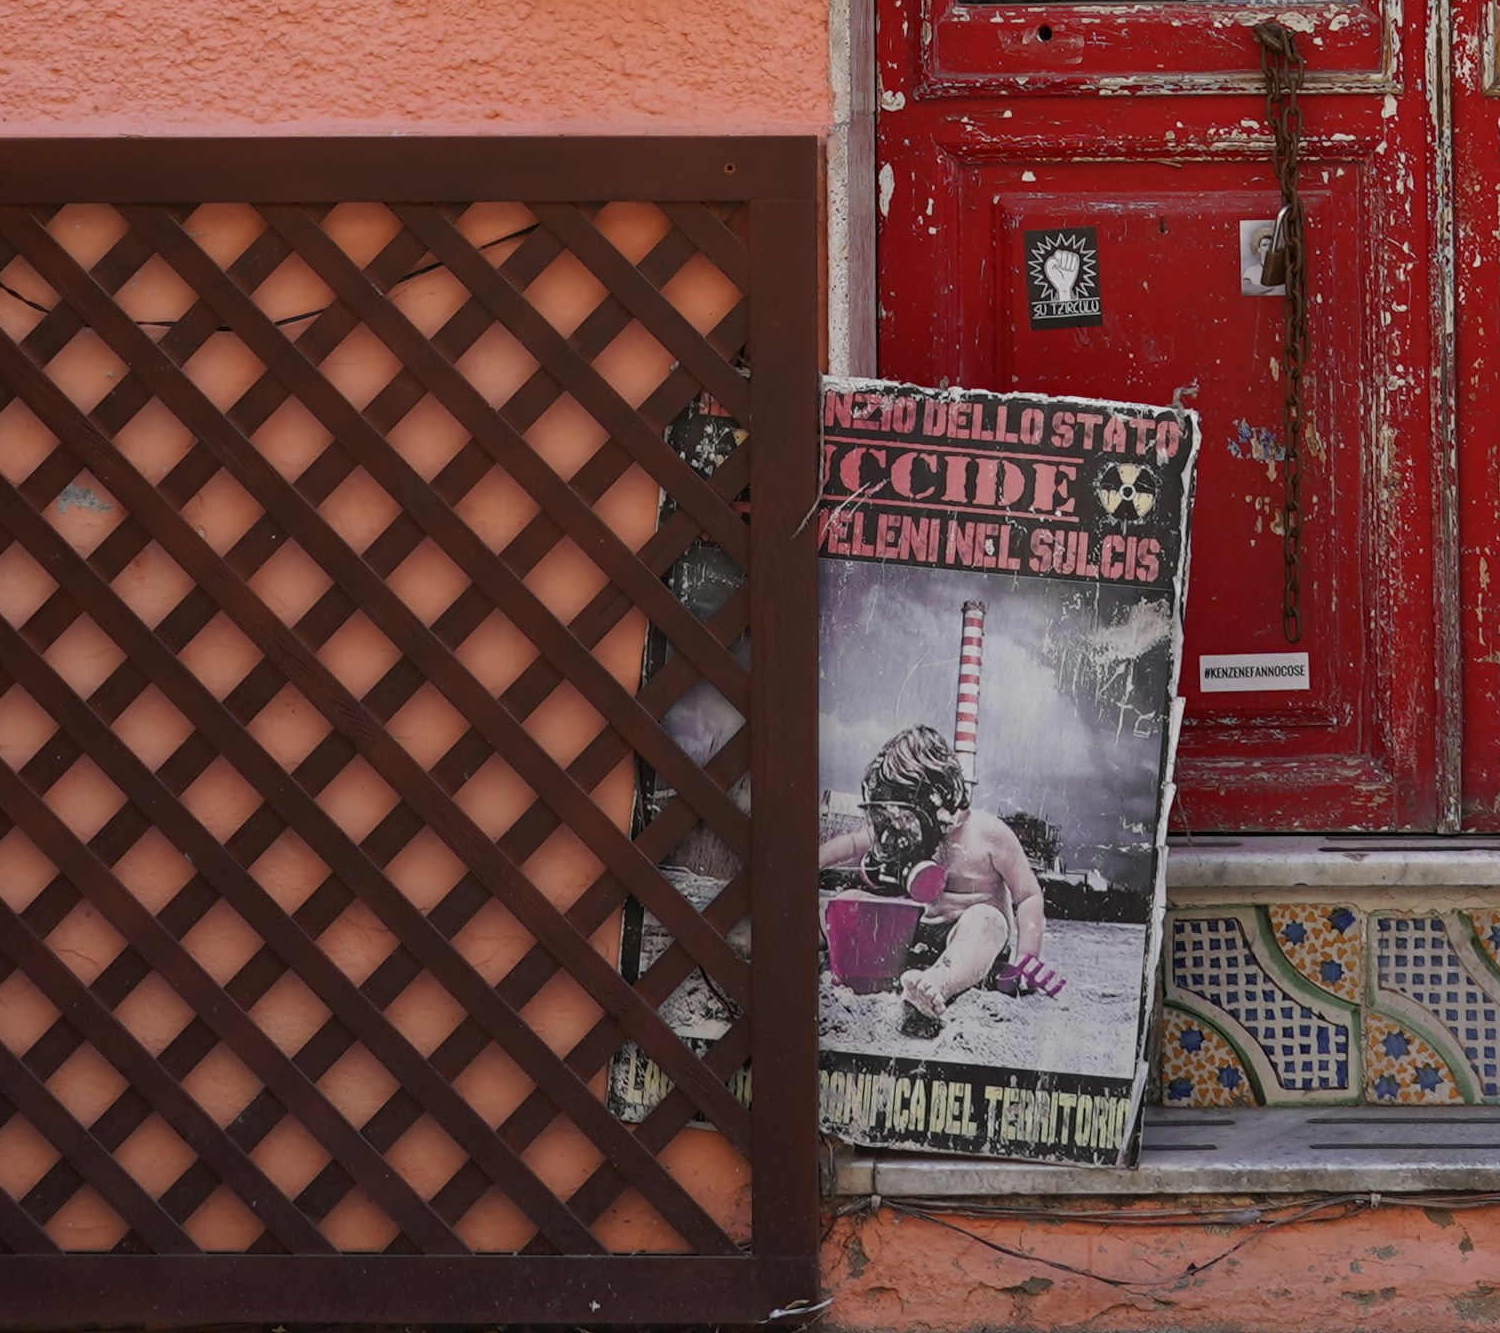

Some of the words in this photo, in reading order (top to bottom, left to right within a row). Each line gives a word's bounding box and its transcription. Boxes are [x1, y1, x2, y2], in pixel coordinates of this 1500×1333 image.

[1033, 304, 1047, 317] SU
[923, 400, 1045, 445] DELLO
[1051, 411, 1181, 458] STATO
[945, 520, 1021, 571] NEL
[1029, 528, 1162, 583] SULCIS
[929, 1079, 977, 1136] DEL
[985, 1085, 1132, 1150] TERRITORIO
